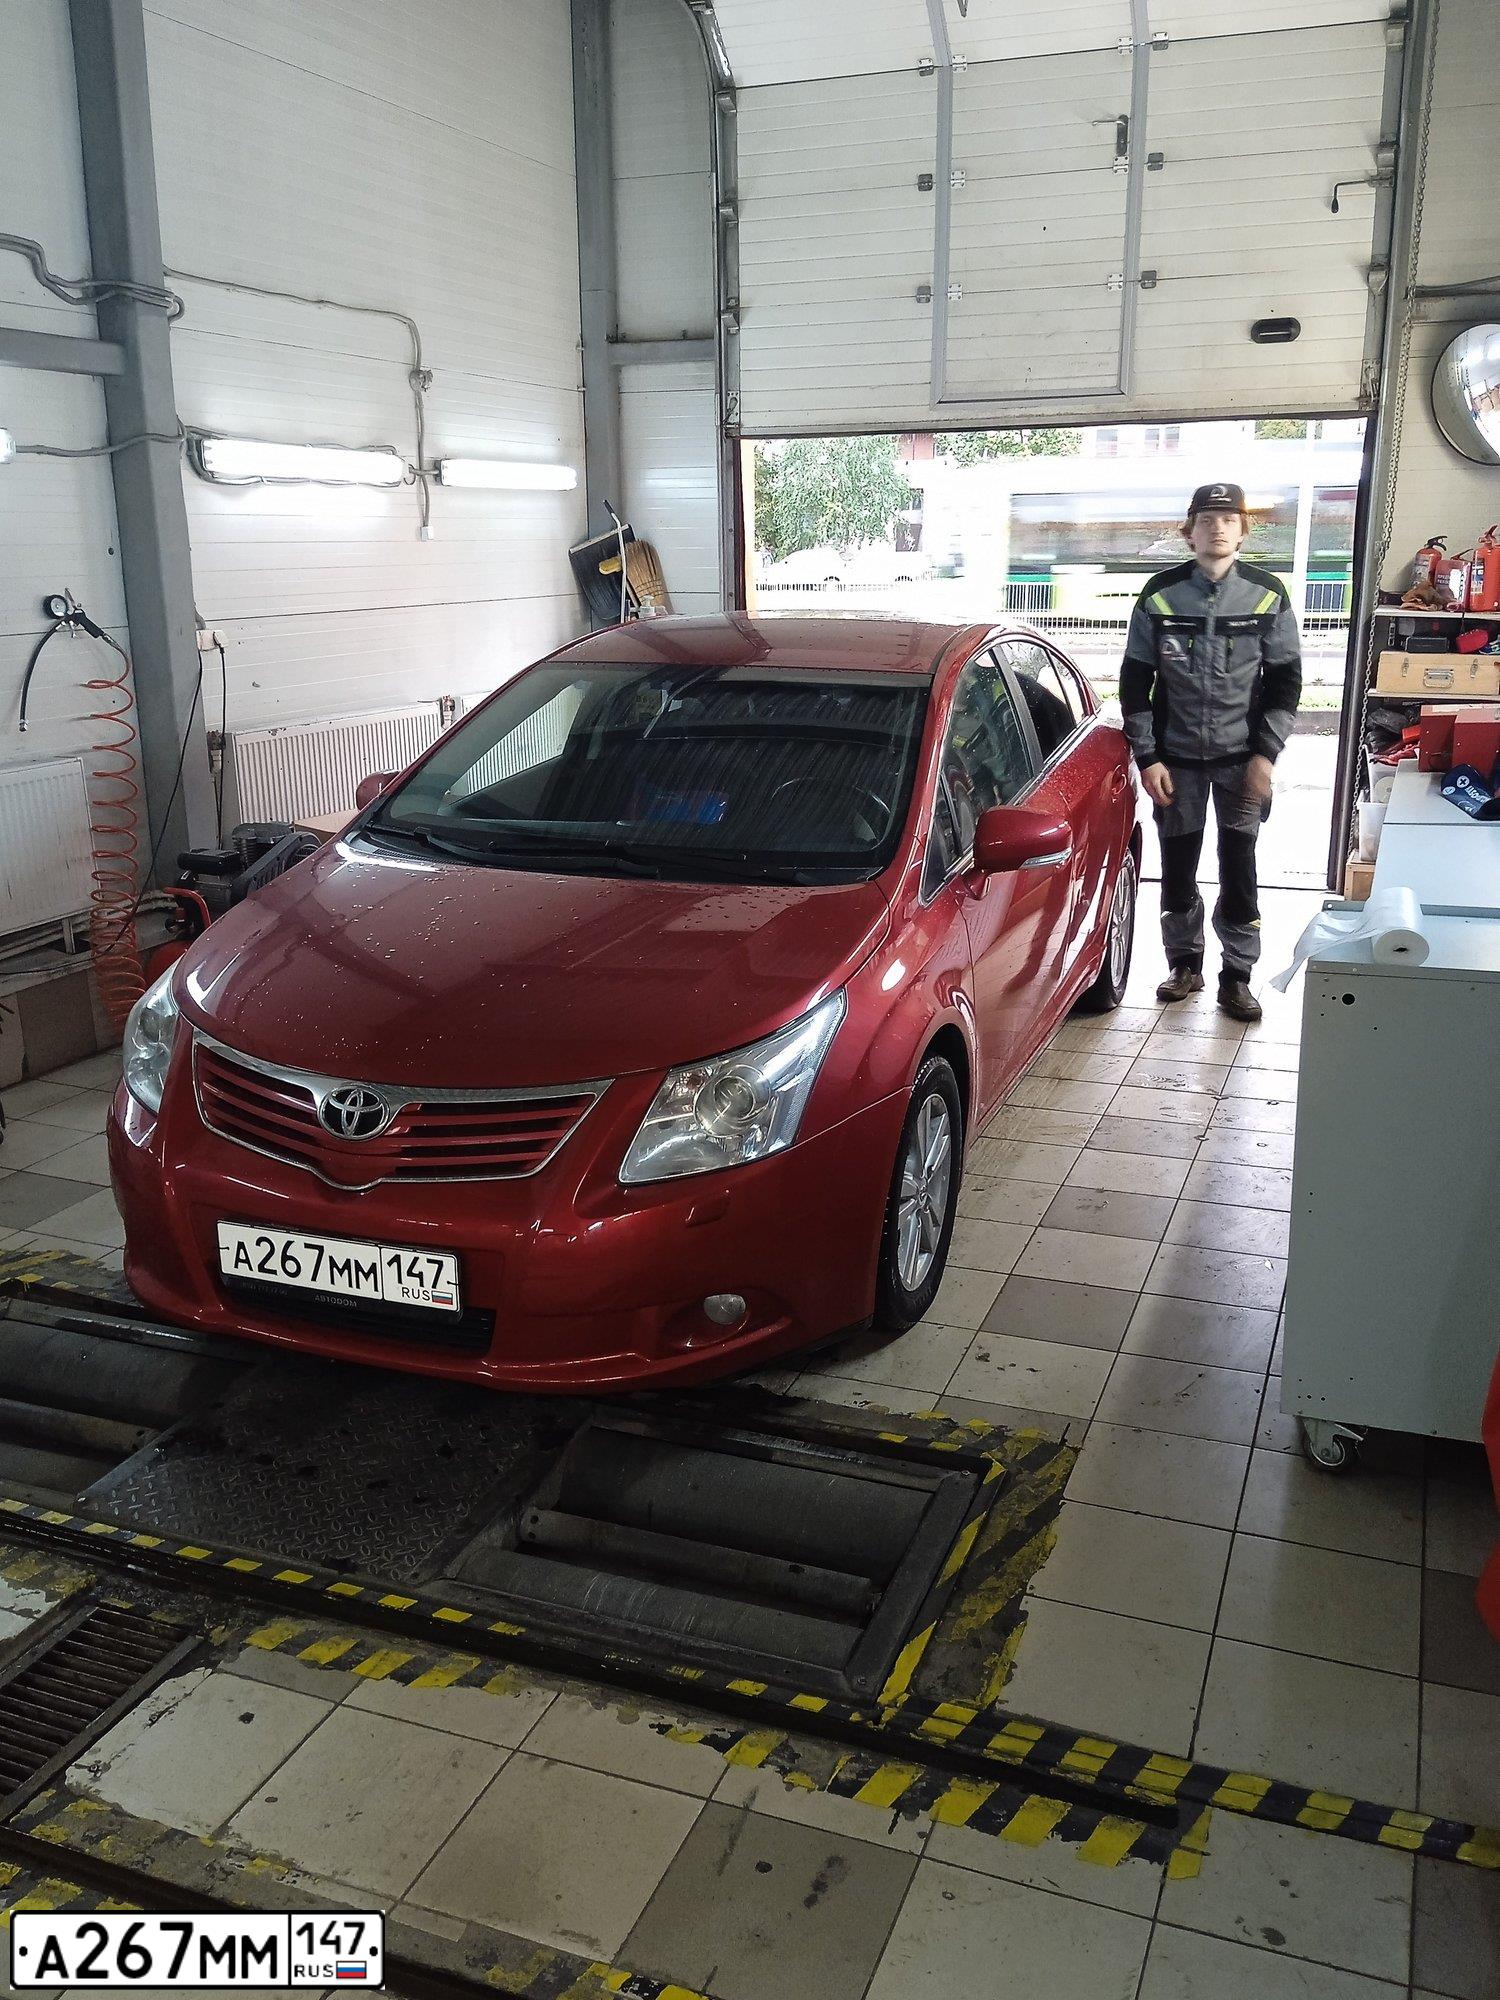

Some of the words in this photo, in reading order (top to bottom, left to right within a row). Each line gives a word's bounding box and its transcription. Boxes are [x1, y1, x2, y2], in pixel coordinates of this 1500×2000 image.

[233, 1236, 379, 1292] А267ММ
[387, 1254, 444, 1289] 147
[401, 1286, 430, 1301] RUS
